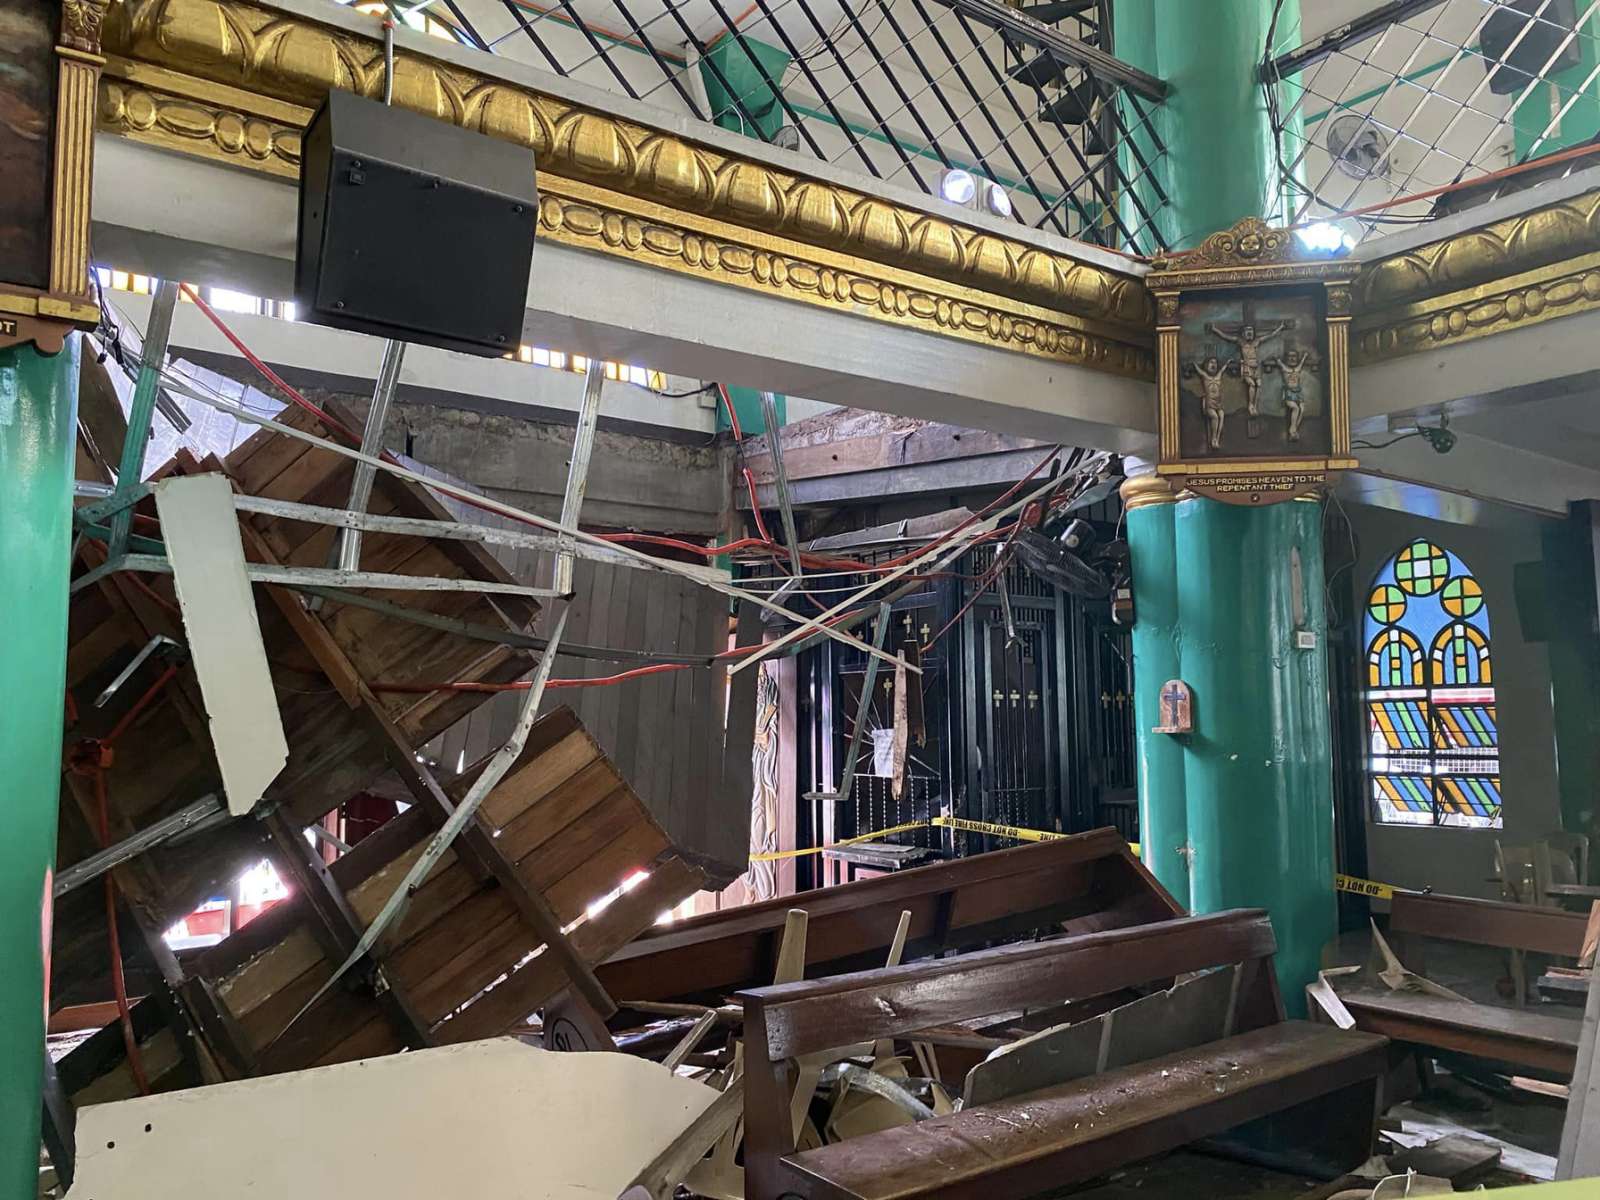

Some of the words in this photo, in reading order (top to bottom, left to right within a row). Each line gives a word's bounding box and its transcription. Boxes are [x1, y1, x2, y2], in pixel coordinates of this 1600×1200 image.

[1186, 478, 1215, 486] JESUS
[1216, 477, 1258, 485] PROMISES
[1295, 475, 1306, 483] TO
[1217, 484, 1268, 492] REPENTANT
[969, 822, 991, 833] CROSS
[992, 825, 1006, 835] NOT
[1347, 880, 1365, 893] NOT
